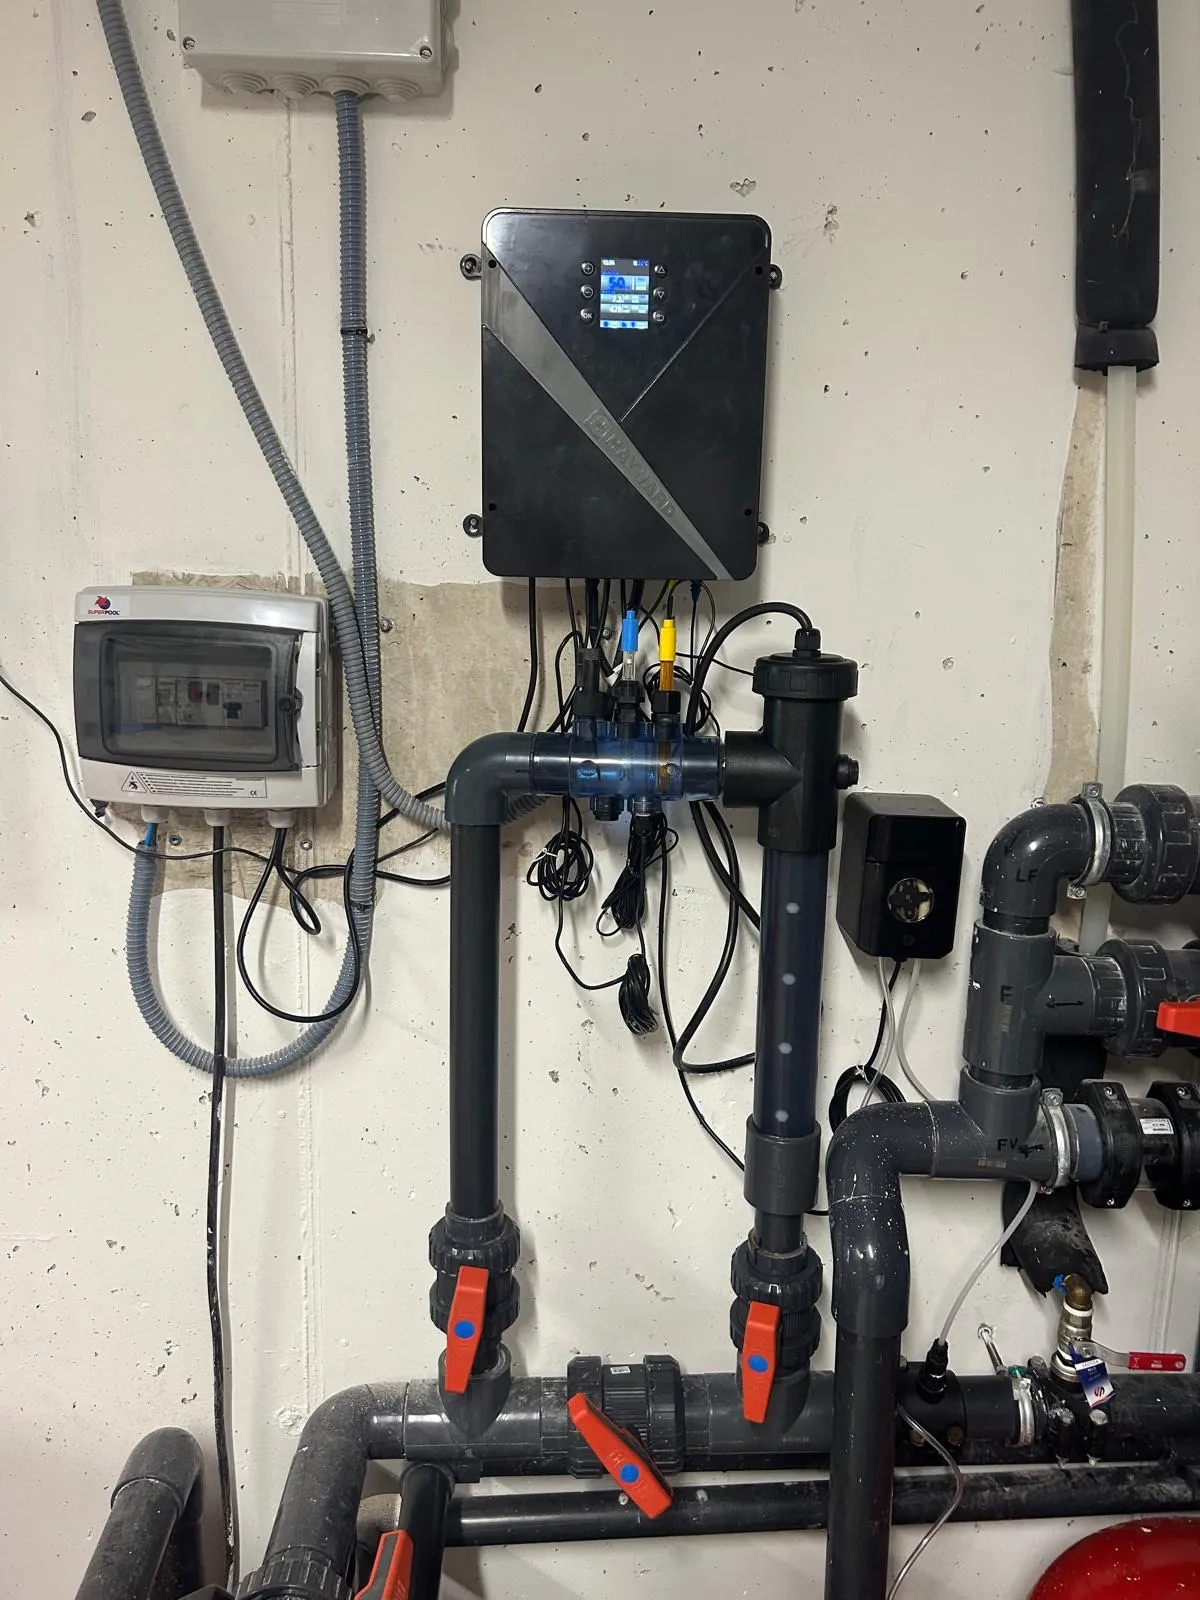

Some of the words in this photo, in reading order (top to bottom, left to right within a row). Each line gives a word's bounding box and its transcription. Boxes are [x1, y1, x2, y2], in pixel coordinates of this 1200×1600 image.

[1015, 867, 1038, 883] LF
[1000, 985, 1013, 1002] F
[997, 1137, 1019, 1151] FV
